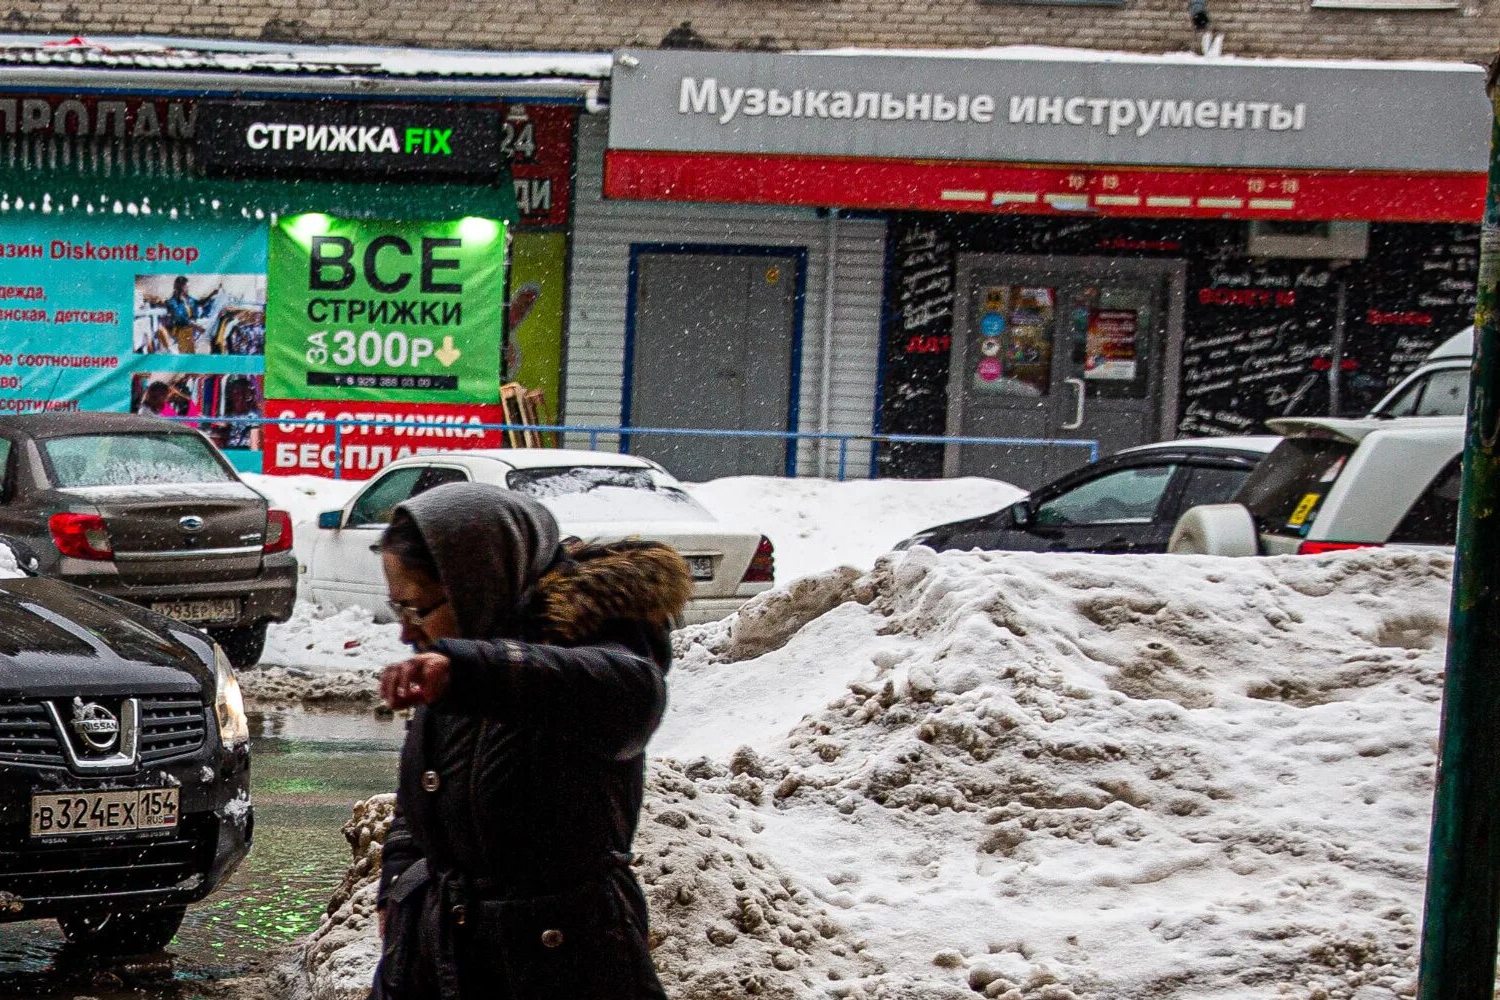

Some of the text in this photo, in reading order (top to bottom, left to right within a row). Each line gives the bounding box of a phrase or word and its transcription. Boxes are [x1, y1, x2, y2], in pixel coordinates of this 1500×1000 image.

[678, 76, 1306, 137] Музыкальные инструменты
[246, 122, 452, 154] СТРИЖКА FIX
[51, 239, 199, 266] Diskontt.shop
[308, 235, 463, 294] ВСЕ
[53, 309, 119, 325] детская;
[307, 298, 462, 326] СТРИЖКИ
[17, 353, 119, 369] соотношение
[307, 331, 329, 366] ЗА
[334, 411, 485, 439] СТРИЖКА
[84, 721, 118, 730] NISSAN
[40, 791, 175, 830] В324ЕХ 154
[146, 815, 163, 825] RUS
